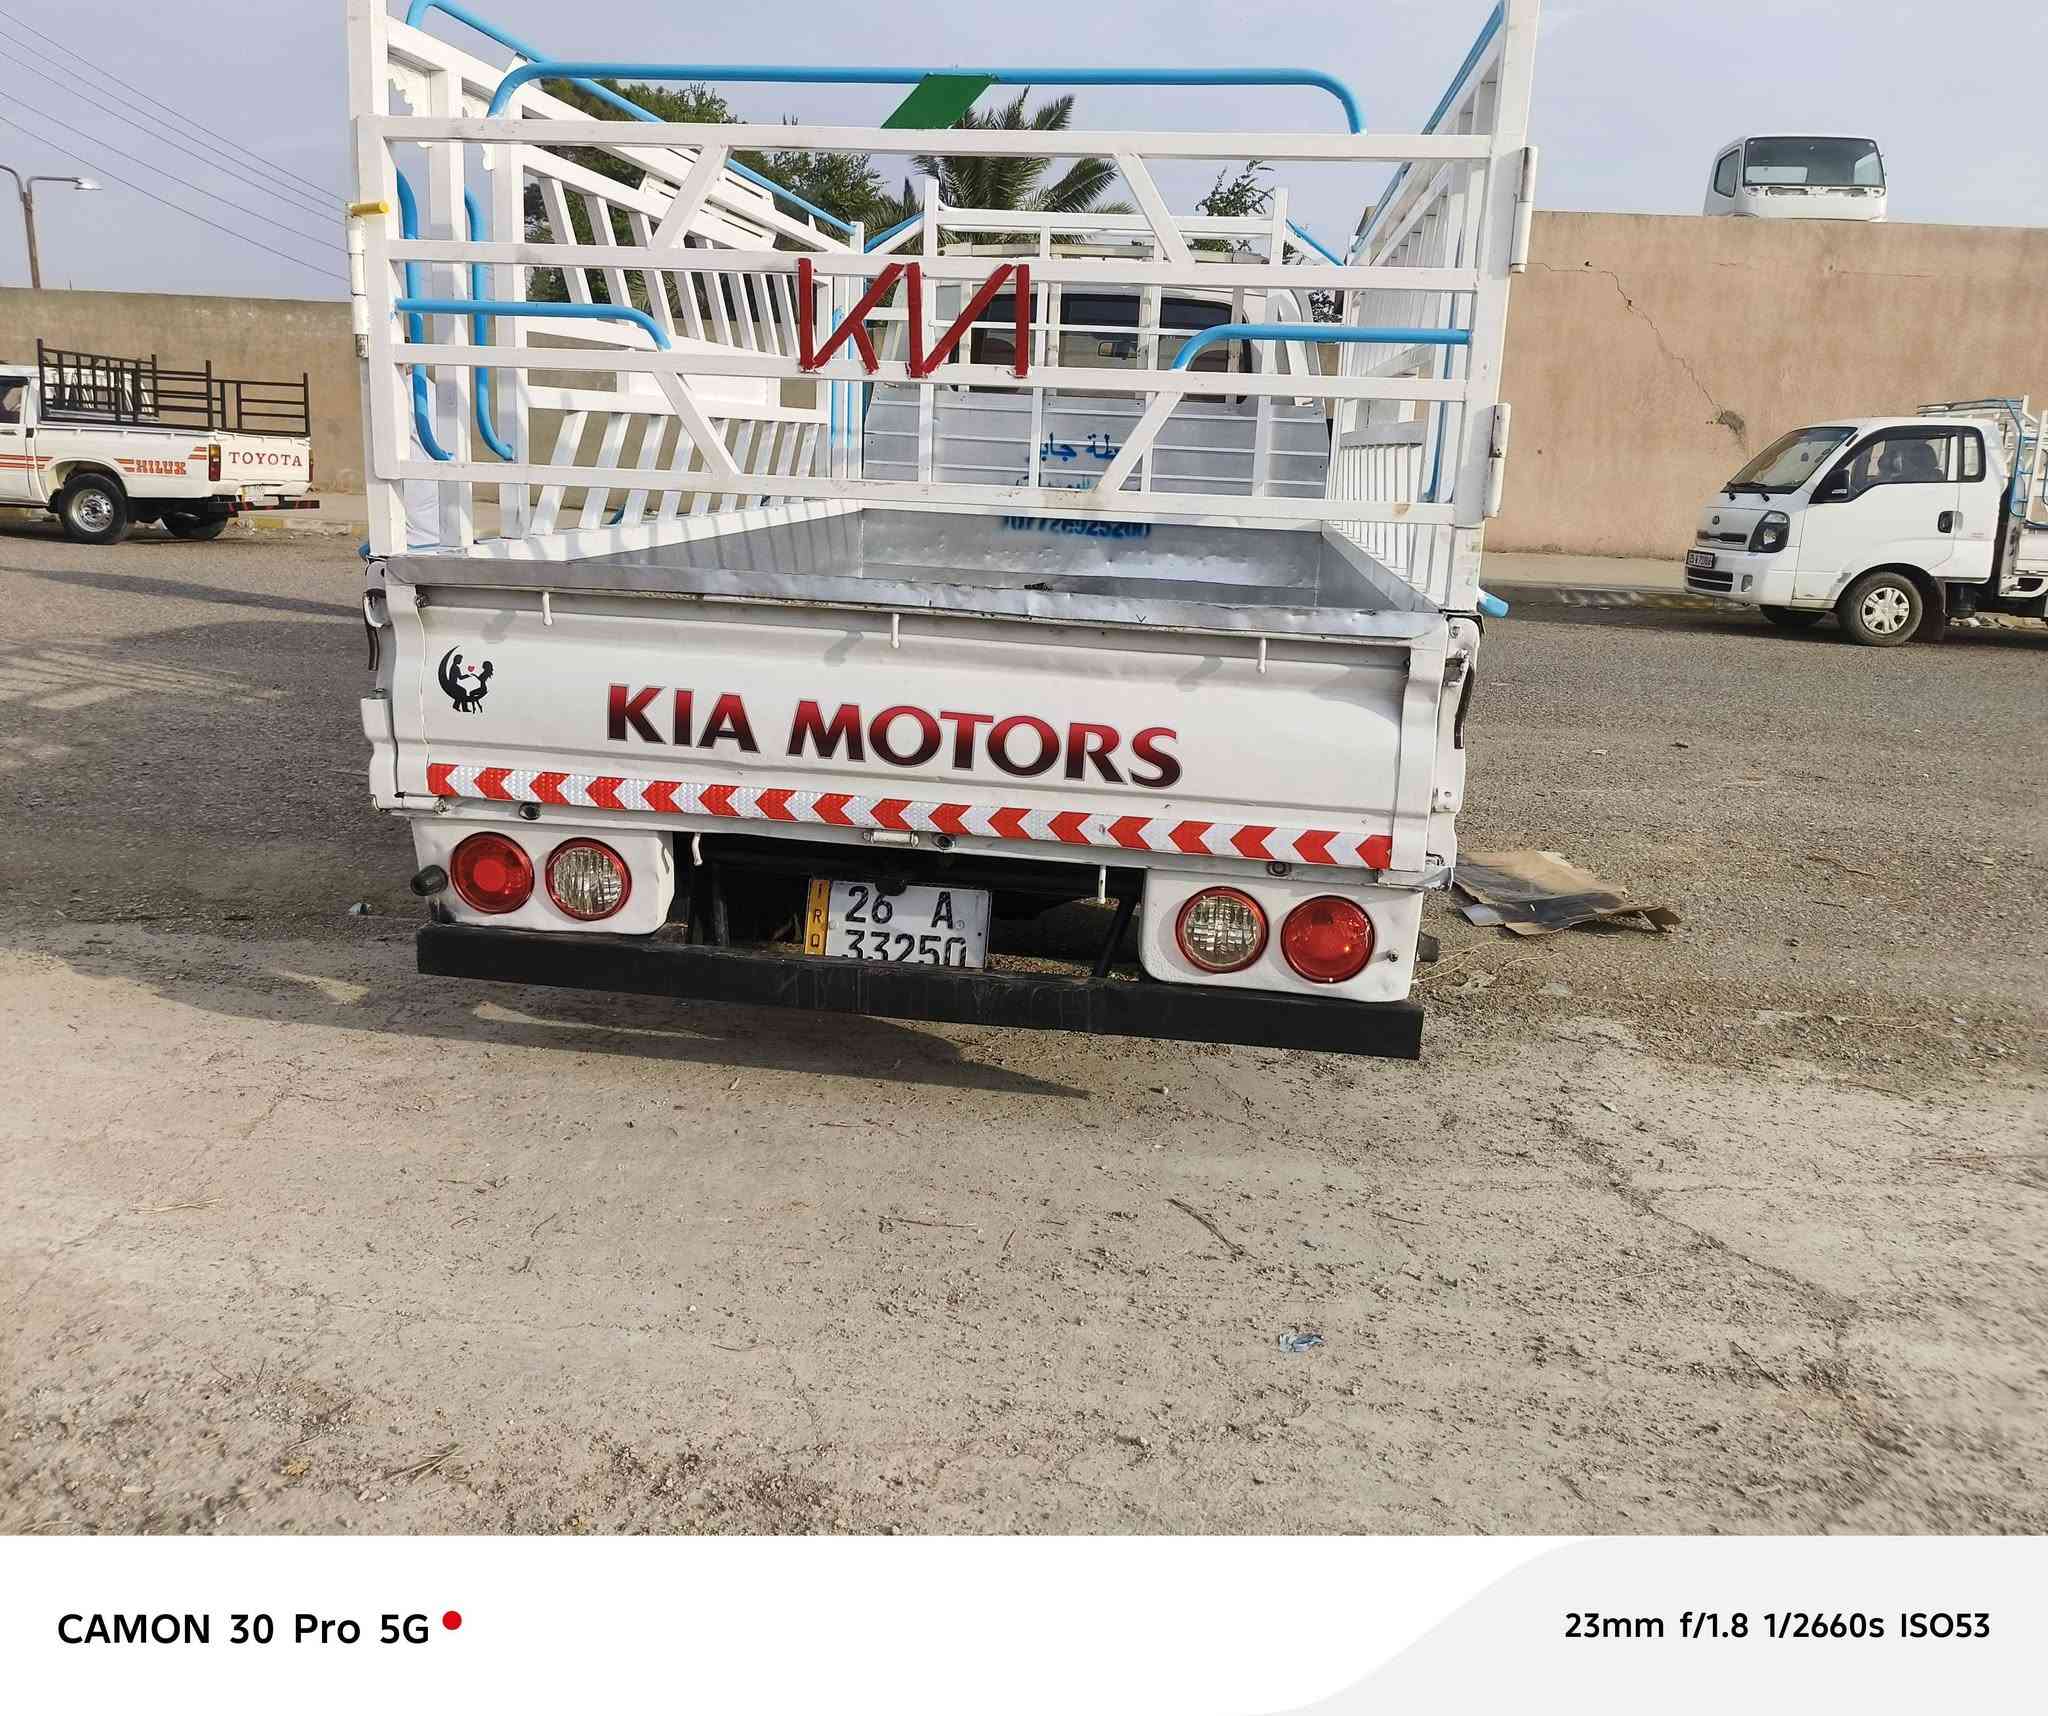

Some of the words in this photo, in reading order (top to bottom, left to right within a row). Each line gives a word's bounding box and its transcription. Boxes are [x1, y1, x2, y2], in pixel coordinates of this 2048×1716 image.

[135, 459, 187, 476] HILUX
[228, 451, 303, 467] TOYOTA
[607, 682, 761, 754] KIA
[786, 697, 1184, 791] MOTORS
[845, 885, 894, 925] 26
[931, 890, 954, 930] A
[845, 929, 968, 969] 33250
